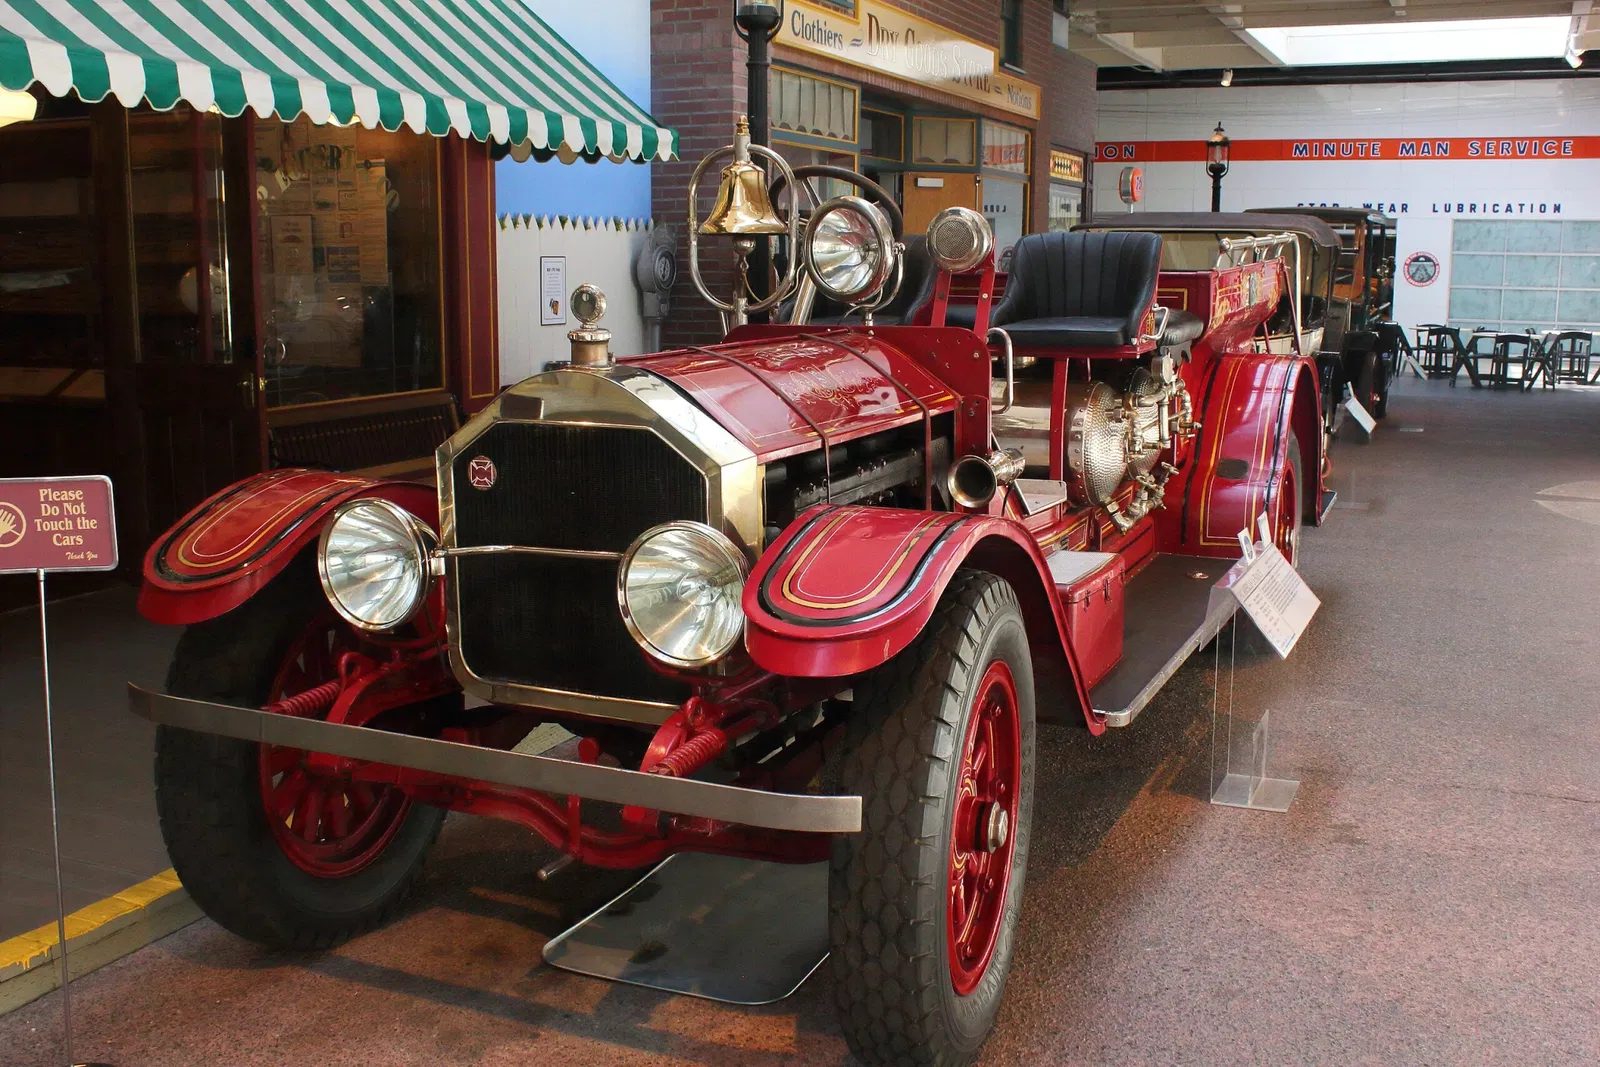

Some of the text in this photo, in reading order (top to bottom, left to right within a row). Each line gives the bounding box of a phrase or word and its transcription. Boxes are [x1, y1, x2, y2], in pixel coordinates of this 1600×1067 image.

[791, 9, 843, 52] Clothiers
[1007, 83, 1032, 110] Notions
[1292, 140, 1574, 157] MINUTE MAN SERVICE
[1432, 203, 1561, 213] LUBRICATION
[39, 488, 84, 501] Please
[40, 502, 87, 516] Do Not
[34, 516, 98, 531] Touch the
[52, 533, 84, 546] Cars
[65, 551, 98, 561] Thank You
